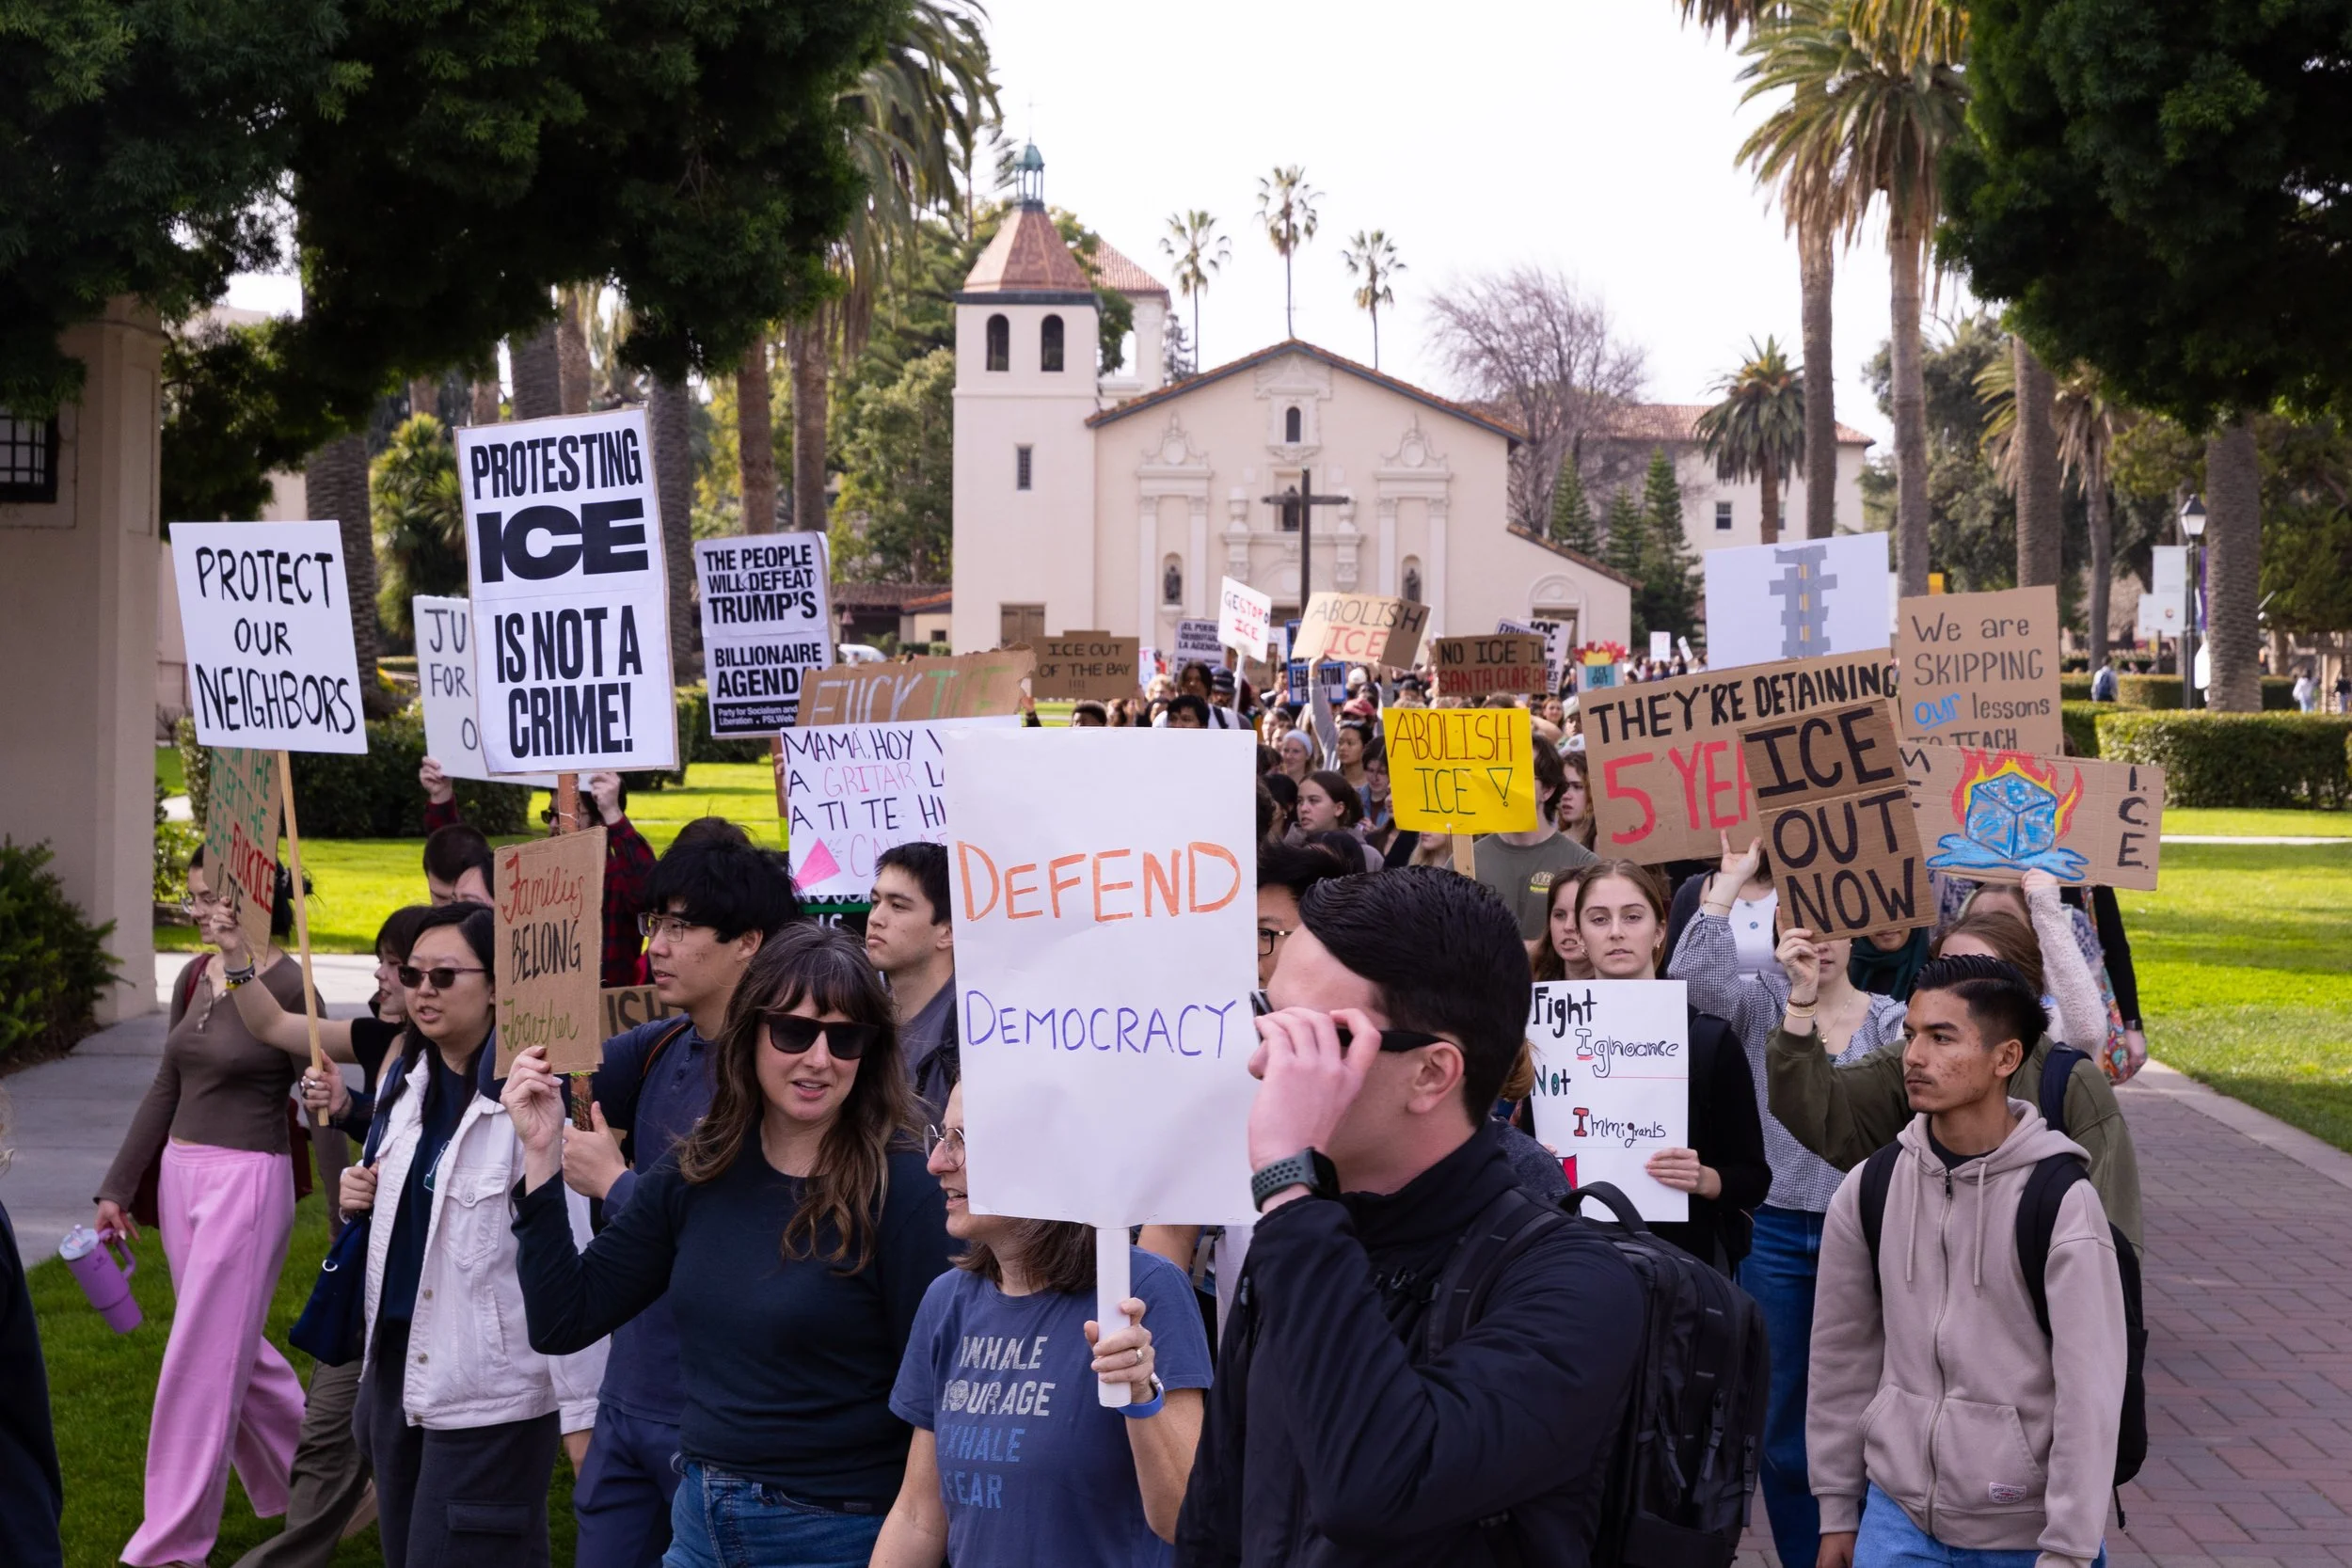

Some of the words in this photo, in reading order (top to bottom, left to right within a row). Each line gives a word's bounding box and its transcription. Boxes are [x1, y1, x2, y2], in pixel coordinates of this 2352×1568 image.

[470, 428, 644, 499] PROTESTING
[476, 498, 649, 583] ICE
[703, 549, 737, 572] THE
[741, 545, 813, 569] PEOPLE
[196, 546, 333, 609] PROTECT
[707, 574, 745, 594] WILL
[749, 569, 814, 591] DEFEAT
[708, 591, 818, 625] TRUMP'S
[1311, 599, 1422, 633] ABOLISH
[234, 617, 292, 656] OUR
[494, 612, 527, 684] IS
[532, 607, 608, 681] NOT
[618, 605, 643, 676] A
[1234, 618, 1259, 641] ICE
[1325, 626, 1390, 657] ICE
[1911, 612, 1962, 642] We
[1980, 618, 2029, 639] are
[714, 642, 822, 668] BILLIONAIRE
[1048, 642, 1085, 657] ICE
[1089, 642, 1122, 657] OUT
[1190, 641, 1222, 652] AGENDA
[1441, 642, 1464, 666] NO
[1475, 641, 1518, 664] ICE
[430, 663, 471, 697] FOR
[1039, 663, 1060, 678] OF
[1068, 662, 1104, 677] THE
[1106, 663, 1132, 676] BAY
[1438, 668, 1493, 693] SANTA
[1914, 649, 2043, 686] SKIPPING
[195, 663, 356, 735] NEIGHBORS
[718, 708, 735, 718] Party
[736, 707, 746, 716] for
[747, 705, 781, 715] Socialism
[810, 673, 923, 725] FUCK
[1589, 681, 1747, 744] THEY'RE
[1753, 662, 1897, 718] DETAINING
[1972, 692, 2050, 720] lessons
[508, 682, 633, 759] CRIME!
[719, 717, 753, 726] Liberation
[1390, 712, 1513, 763] ABOLISH
[868, 729, 913, 761] HOY
[1744, 706, 1895, 798] ICE
[788, 769, 811, 797] A
[823, 761, 916, 798] GRITAR
[790, 806, 814, 835] A
[818, 800, 848, 831] TI
[861, 797, 898, 830] TE
[1603, 752, 1656, 845] 5
[1772, 789, 1906, 869] OUT
[230, 821, 254, 895] FUCK
[252, 849, 277, 914] ICE
[957, 841, 1241, 922] DEFEND
[1786, 857, 1915, 933] NOW
[512, 918, 581, 986] BELONG
[966, 990, 1236, 1059] DEMOCRACY
[1533, 987, 1597, 1038] Fight
[1533, 1065, 1571, 1096] Not
[1573, 1107, 1666, 1148] Immigrants
[959, 1336, 1048, 1370] INHALE
